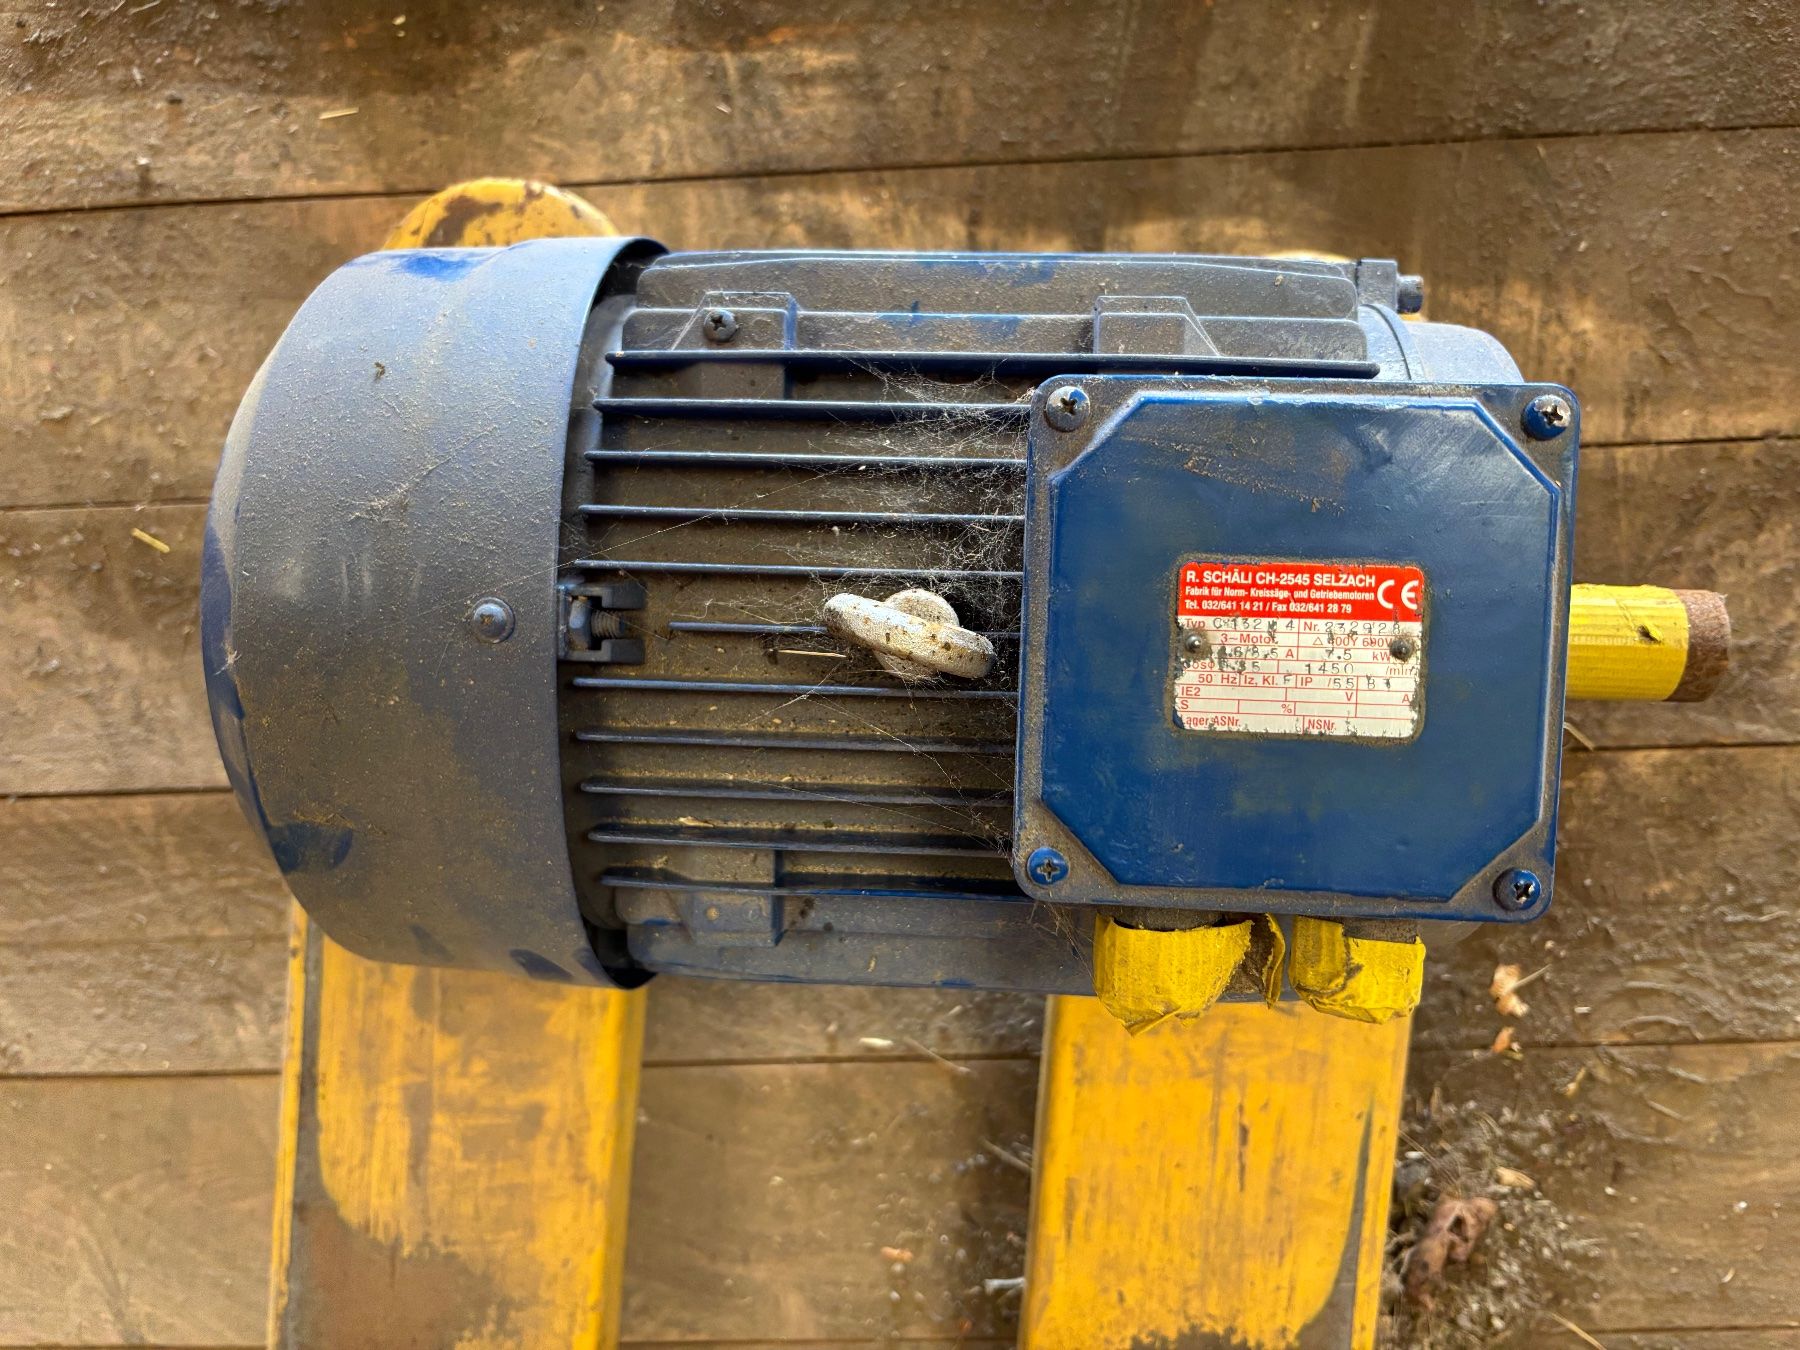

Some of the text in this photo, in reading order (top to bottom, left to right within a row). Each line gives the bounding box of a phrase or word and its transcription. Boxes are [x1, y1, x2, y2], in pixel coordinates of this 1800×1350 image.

[1186, 568, 1376, 588] R. SCHÄLI CH-2545 SELZACH
[1185, 586, 1210, 596] Fabrik
[1211, 586, 1222, 596] für
[1223, 587, 1249, 597] Norm-
[1294, 589, 1308, 599] und
[1310, 589, 1375, 601] Getriebemotoren
[1377, 579, 1419, 610] CE
[1185, 600, 1199, 609] Tel.
[1202, 600, 1237, 610] 032/641
[1240, 601, 1251, 611] 14
[1252, 601, 1263, 612] 21
[1271, 602, 1287, 612] Fax
[1289, 602, 1324, 613] 032/641
[1327, 603, 1338, 613] 28
[1341, 603, 1352, 614] 79
[1185, 618, 1206, 629] Typ
[1303, 621, 1320, 632] Nr.
[1285, 648, 1294, 658] A
[1325, 648, 1391, 661] 7.5 kW
[1305, 662, 1354, 675] 1450
[1198, 673, 1237, 684] 50 Hz
[1300, 676, 1313, 687] IP
[1181, 686, 1201, 697] IE2
[1345, 691, 1354, 702] V
[1402, 693, 1410, 704] A
[1180, 699, 1189, 710] S
[1281, 703, 1292, 714] %
